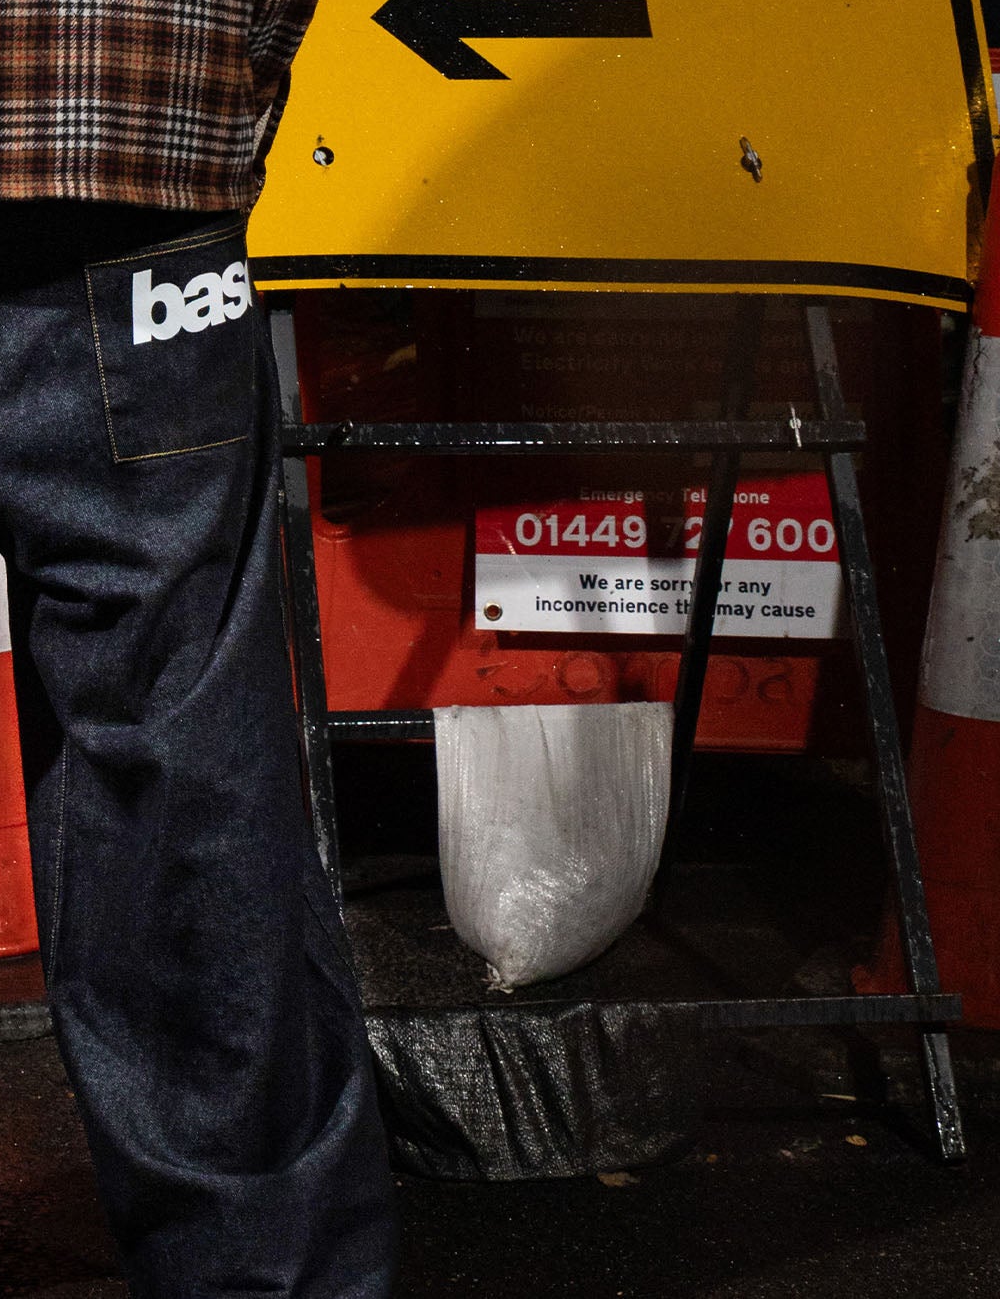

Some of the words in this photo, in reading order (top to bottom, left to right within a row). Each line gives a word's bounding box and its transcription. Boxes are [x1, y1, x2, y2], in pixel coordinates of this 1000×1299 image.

[132, 260, 253, 345] bas
[515, 513, 648, 549] 01449
[747, 517, 836, 552] 600
[579, 574, 608, 590] We
[615, 578, 644, 591] are
[738, 580, 772, 596] any
[535, 596, 669, 615] inconvenience
[716, 603, 755, 620] may
[761, 604, 816, 618] cause
